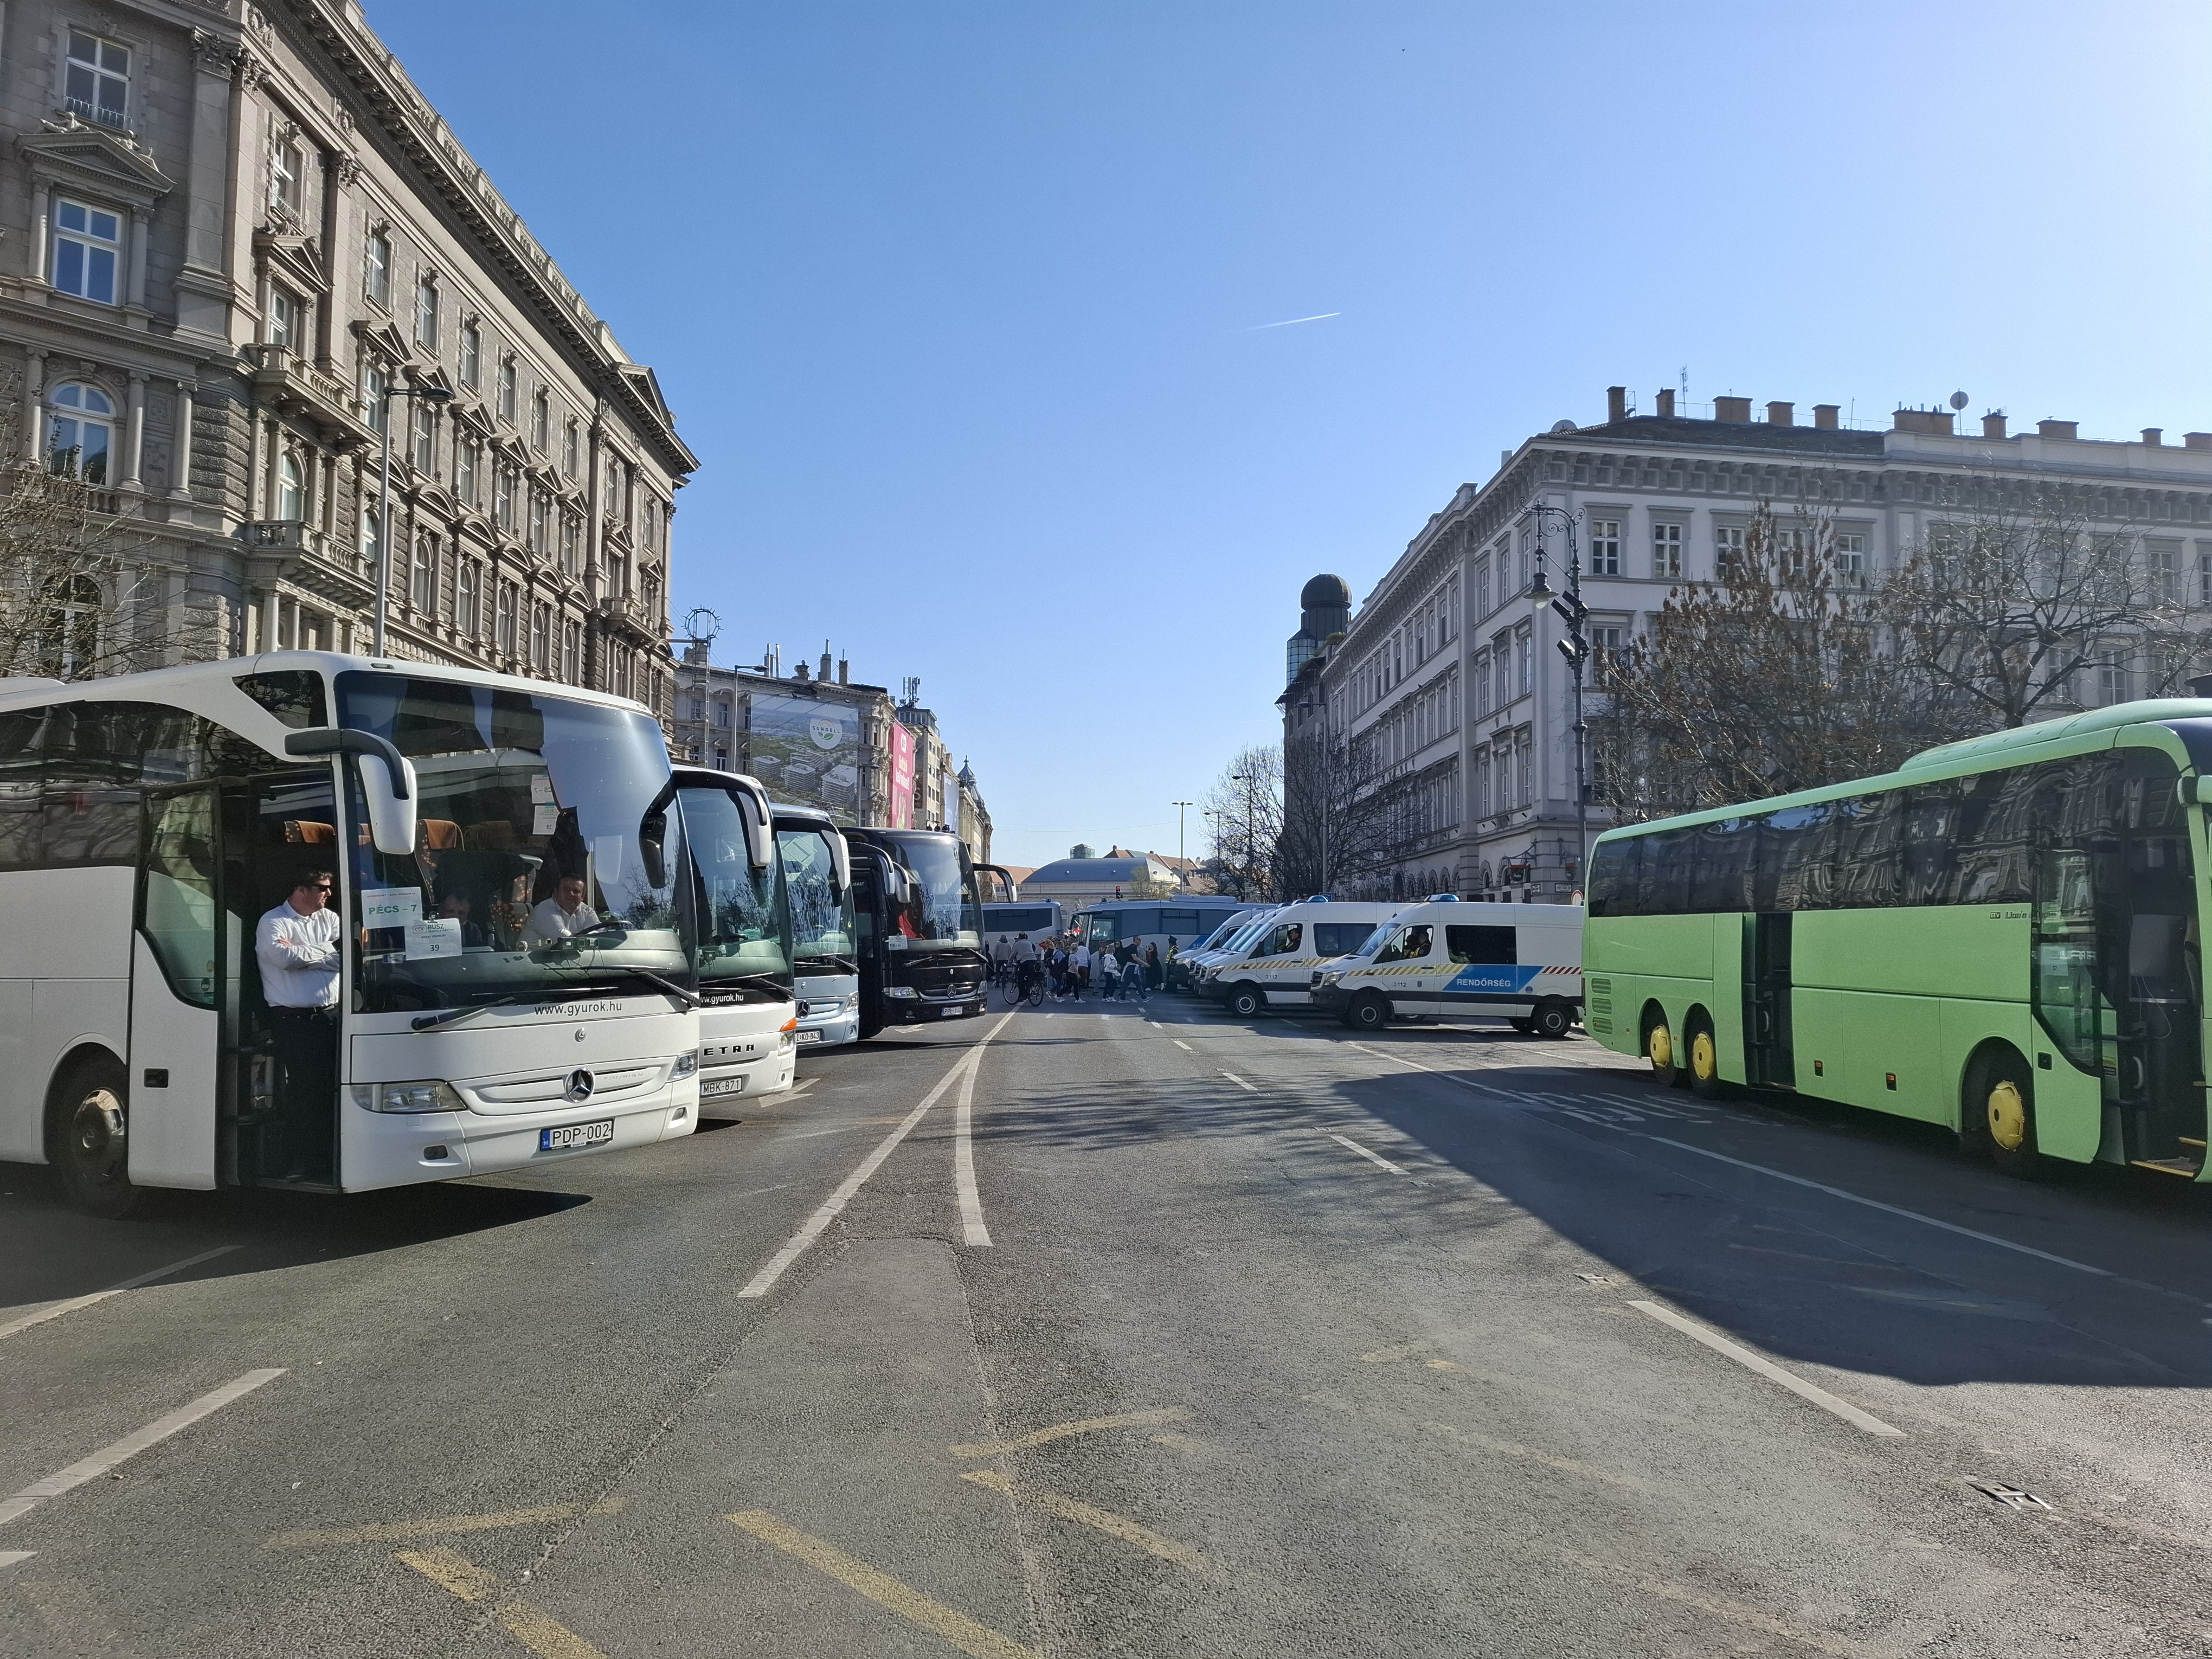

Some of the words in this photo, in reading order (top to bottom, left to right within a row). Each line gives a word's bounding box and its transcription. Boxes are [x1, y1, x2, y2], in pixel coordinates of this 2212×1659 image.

[368, 905, 400, 915] PÉCS
[1457, 978, 1511, 987] RENDŐRSÉG
[699, 993, 744, 1004] ww.gyurok.hu
[534, 1000, 622, 1016] www.gyurok.hu
[704, 1044, 754, 1056] ETRA
[703, 1079, 739, 1094] MBK-871
[552, 1123, 609, 1145] PDP-002
